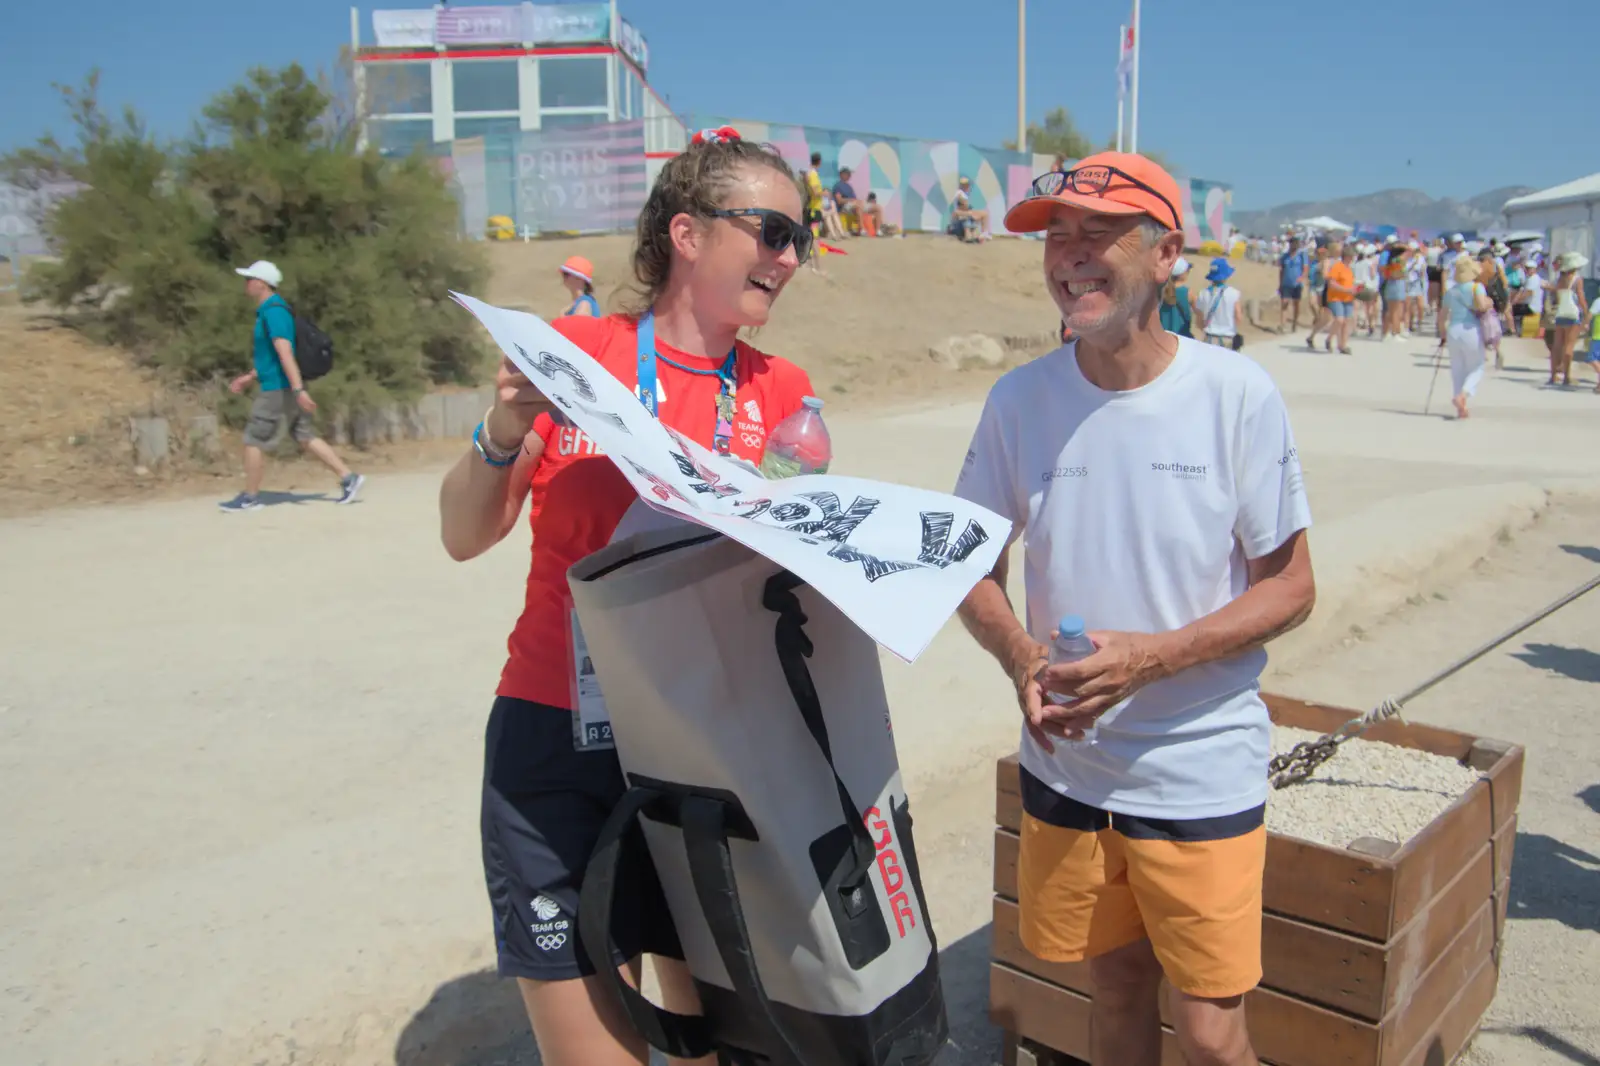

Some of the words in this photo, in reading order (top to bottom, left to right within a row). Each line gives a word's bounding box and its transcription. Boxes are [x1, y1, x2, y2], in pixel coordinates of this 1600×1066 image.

[518, 148, 608, 178] PARIS
[521, 181, 611, 212] 2024
[738, 421, 759, 432] TEAM
[1151, 462, 1207, 474] southeast
[530, 922, 553, 934] TEAM
[554, 920, 569, 931] GB
